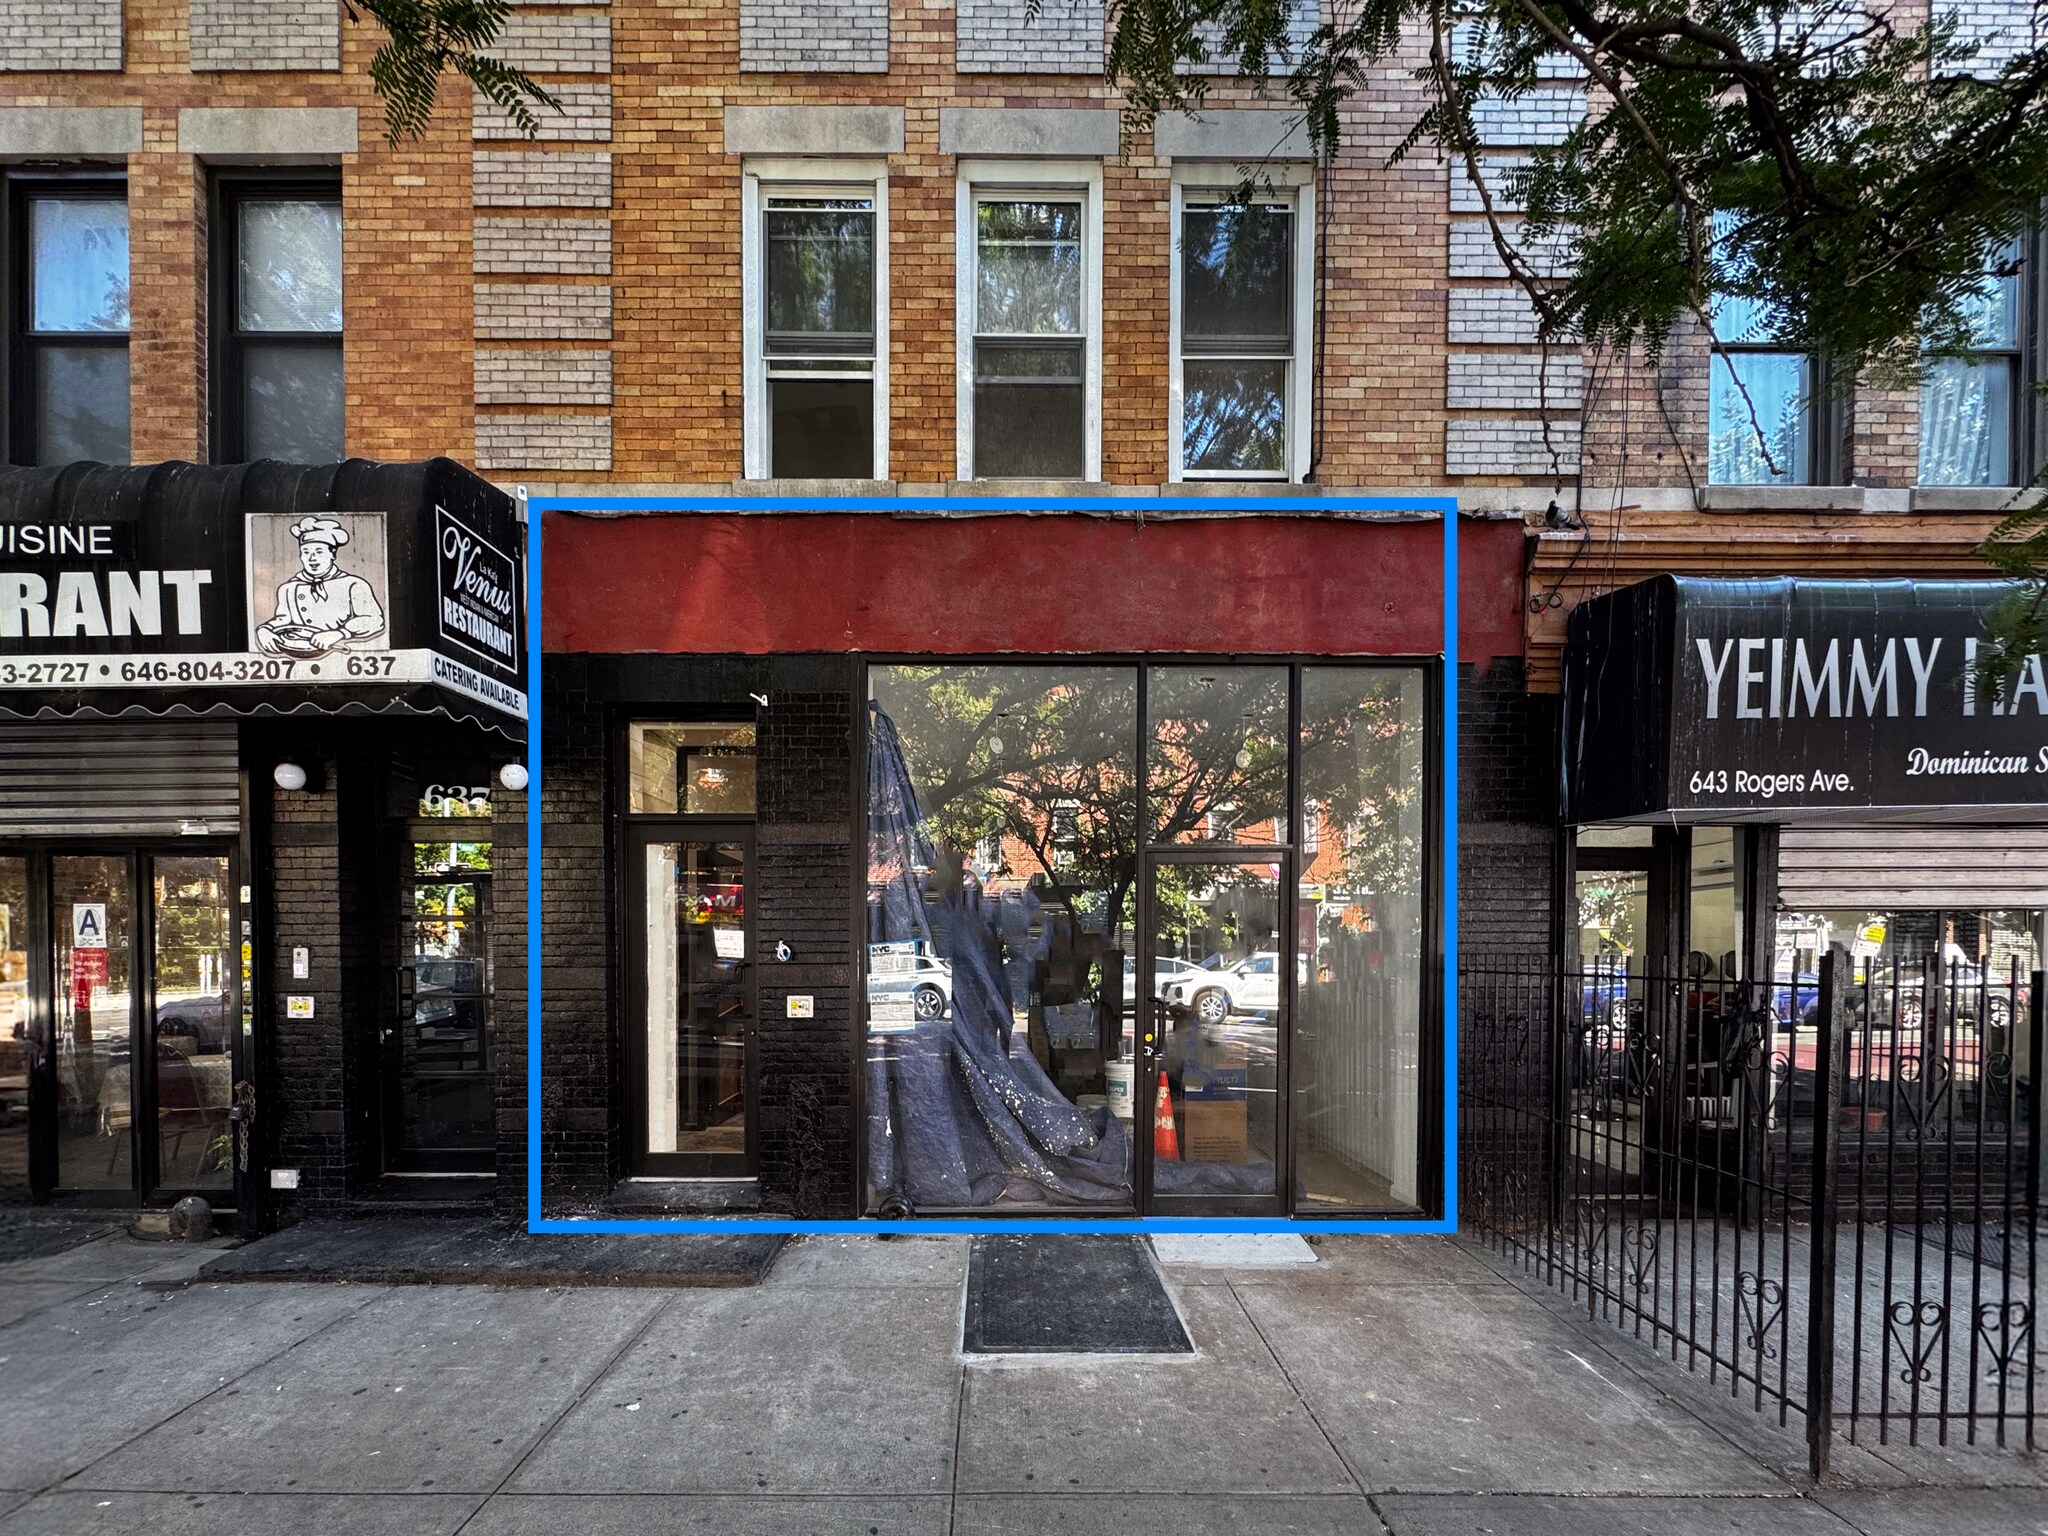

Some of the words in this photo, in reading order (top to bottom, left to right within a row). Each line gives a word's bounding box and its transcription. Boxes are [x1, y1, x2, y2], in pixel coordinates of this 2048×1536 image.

[0, 525, 113, 554] ISINE
[442, 526, 511, 615] Venus
[0, 569, 213, 637] RANT
[443, 596, 513, 657] RESTAURANT
[0, 662, 90, 683] 3-2727
[121, 660, 296, 682] 646-804-3207
[346, 656, 396, 676] 637
[434, 657, 479, 692] CATERING
[479, 676, 519, 711] AVAILABLE
[1695, 637, 1943, 719] YEIMMY
[1905, 747, 2029, 776] Dominican
[1689, 770, 1728, 794] 643
[1735, 769, 1805, 798] Rogers
[1809, 769, 1855, 793] Ave.
[424, 784, 491, 816] 637
[78, 909, 100, 936] A
[871, 945, 890, 953] NYC
